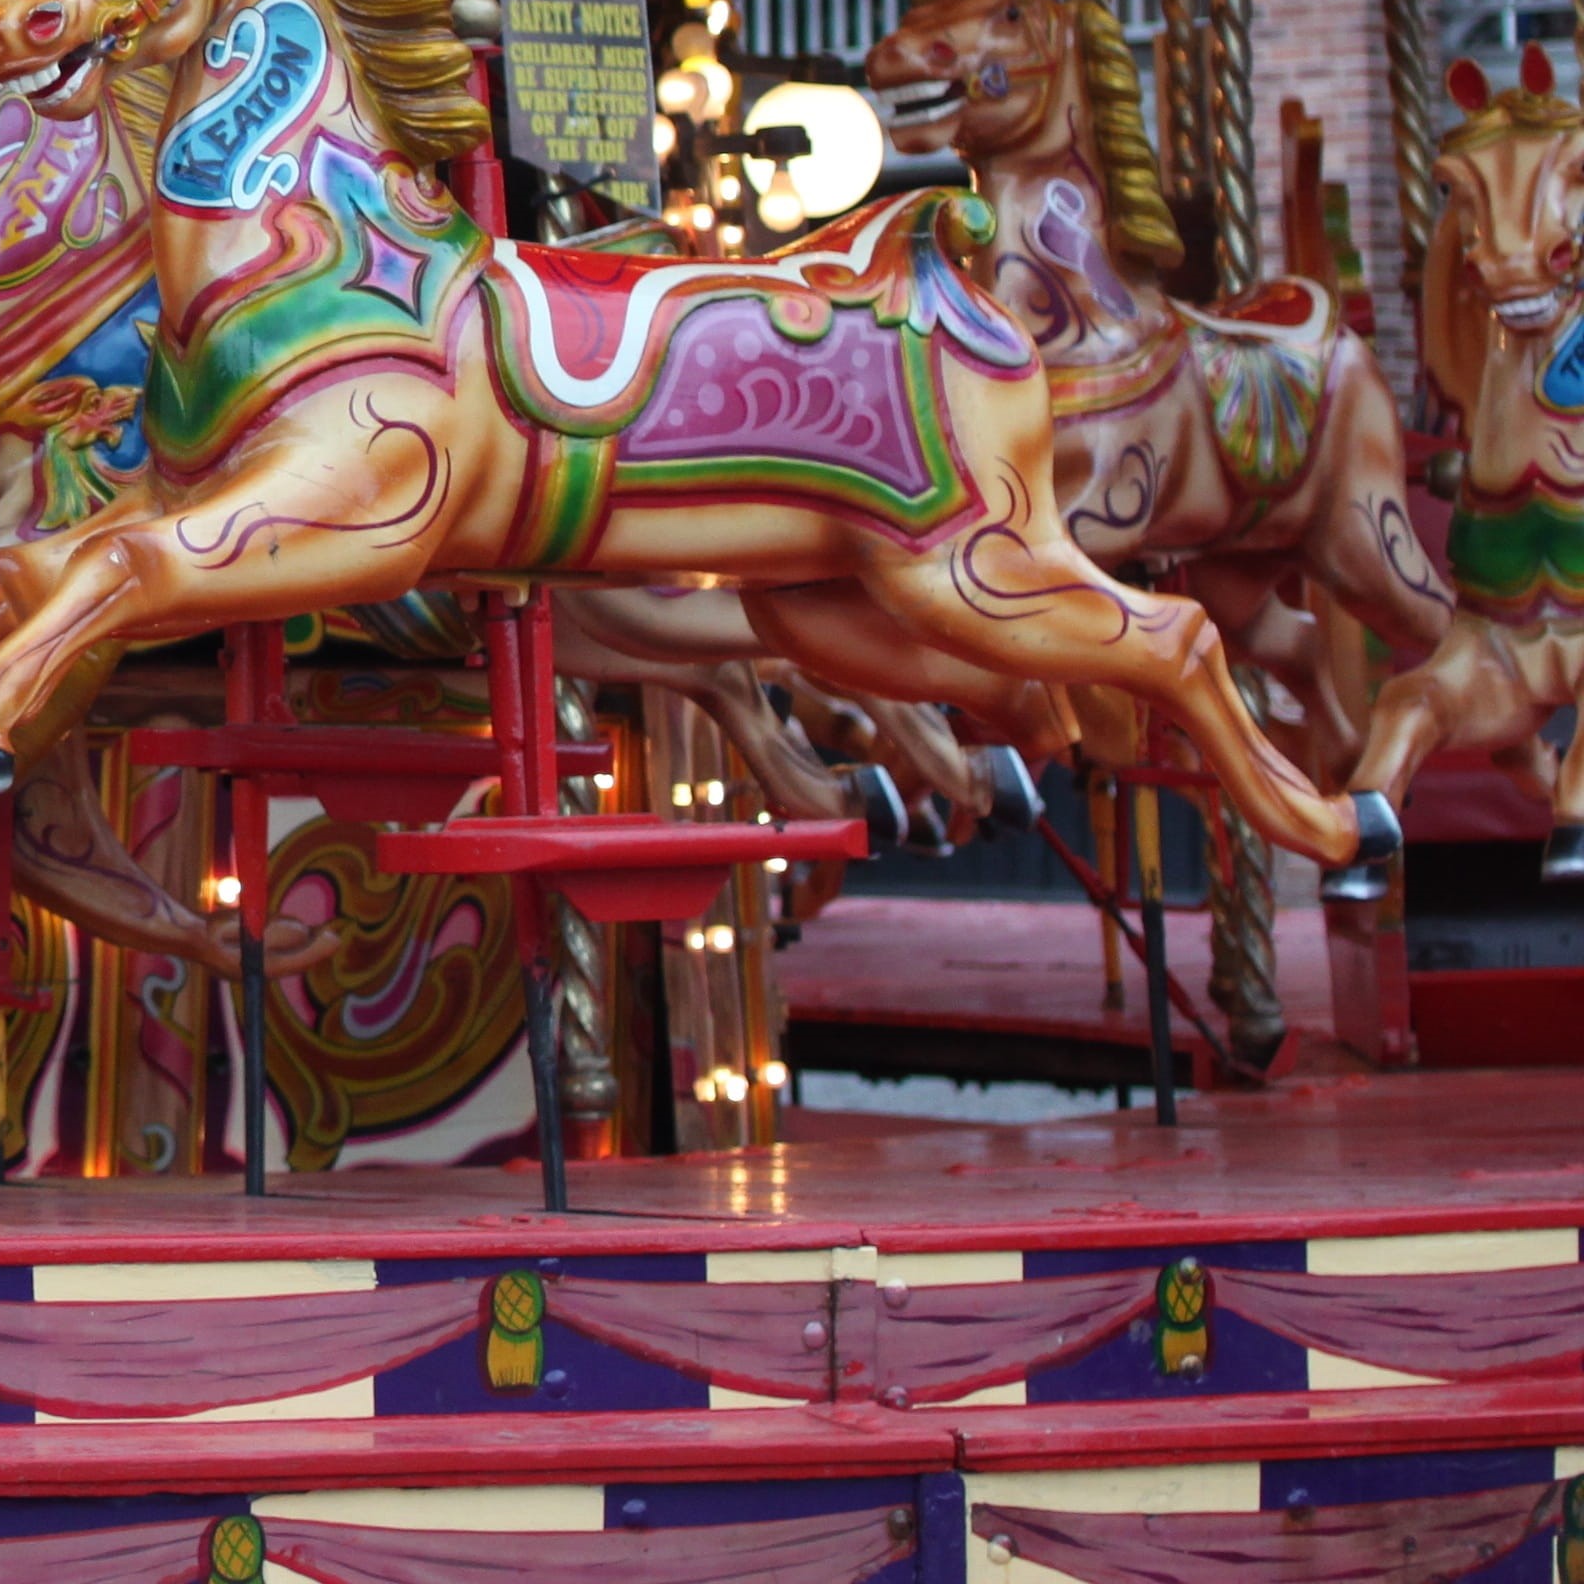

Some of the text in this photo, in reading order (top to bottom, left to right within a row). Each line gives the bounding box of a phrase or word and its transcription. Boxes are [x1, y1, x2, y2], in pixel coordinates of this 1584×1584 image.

[509, 0, 641, 38] SAFETY NOTICE
[510, 42, 646, 69] CHILDREN MUST
[514, 66, 647, 92] BE SUPERVISED
[172, 35, 312, 188] KEATON
[517, 90, 648, 117] WHEN GETTING
[532, 114, 638, 140] ON AND OFF
[545, 138, 627, 163] THE RIDE
